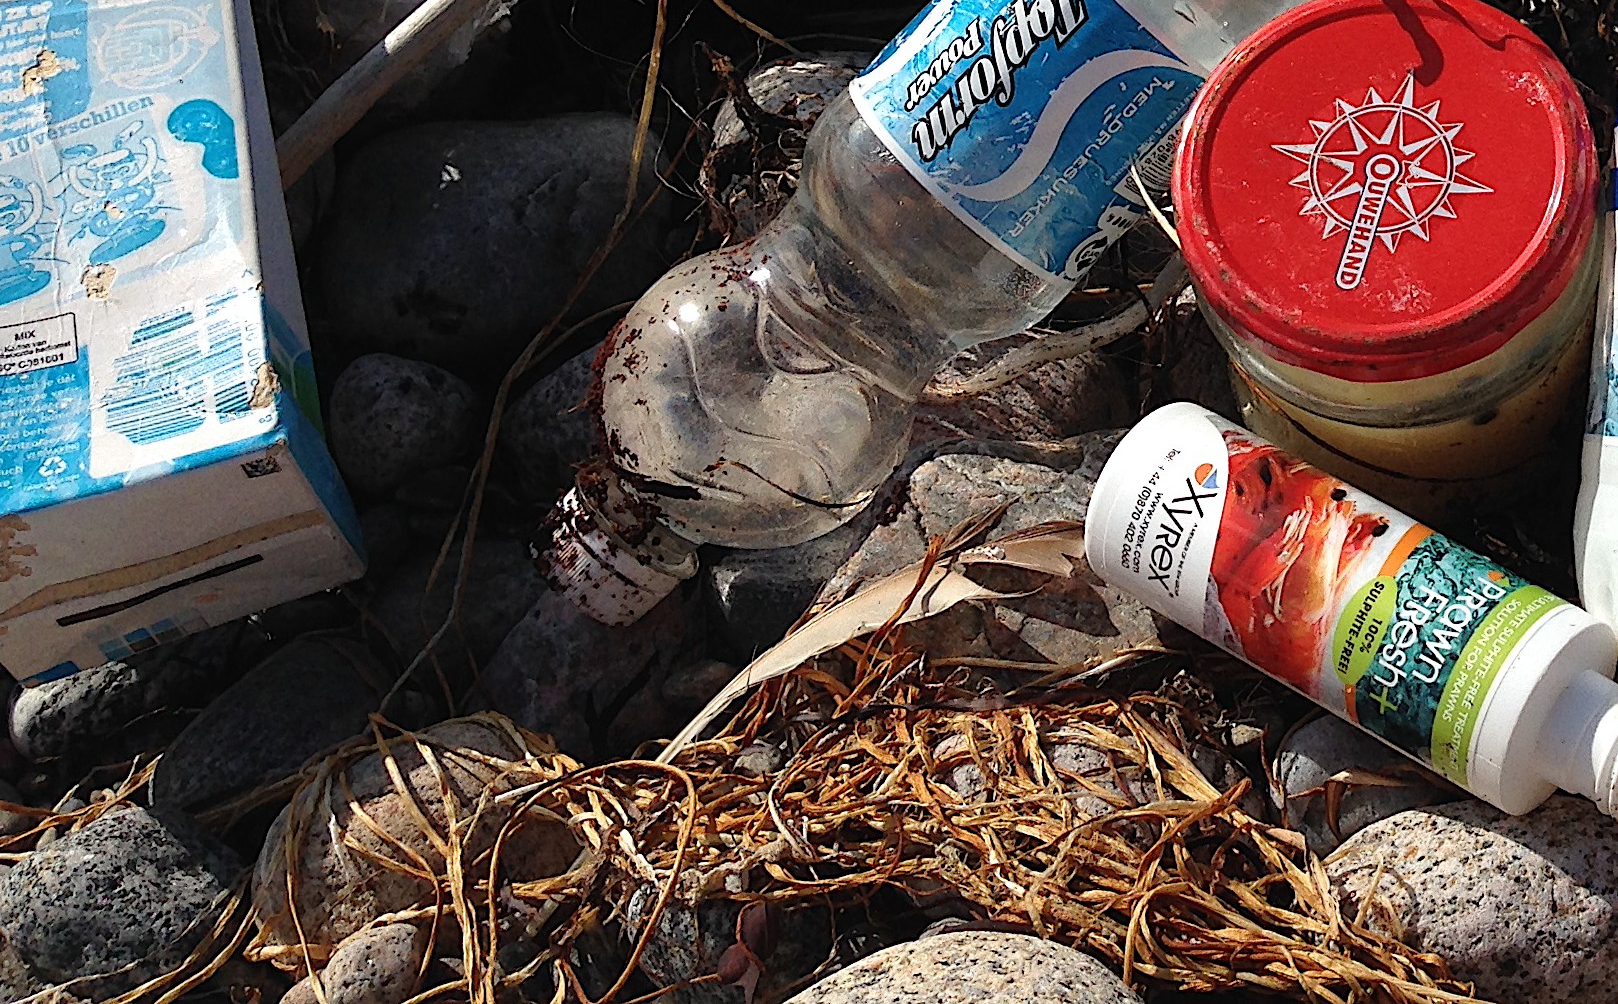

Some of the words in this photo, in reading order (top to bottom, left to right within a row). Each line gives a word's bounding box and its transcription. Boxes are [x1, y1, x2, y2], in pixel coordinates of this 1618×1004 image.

[905, 18, 985, 113] Power
[33, 95, 154, 146] verschillen
[1122, 76, 1162, 118] MED
[1008, 120, 1124, 238] DRUESUKKER
[1340, 157, 1394, 285] OUWEHAND
[14, 329, 36, 342] MIX
[1148, 472, 1160, 486] 44
[1124, 523, 1137, 543] 402
[1133, 492, 1164, 573] www.xyrex.com
[1337, 581, 1385, 675] SULPHITE-FREE!
[1359, 618, 1383, 654] 100%
[1477, 599, 1522, 647] SOLUTION
[1514, 595, 1550, 629] ULTIMATE
[1461, 624, 1514, 710] SULPHITE-FREE
[1464, 645, 1482, 672] FOR
[1442, 671, 1469, 723] PRAWNS
